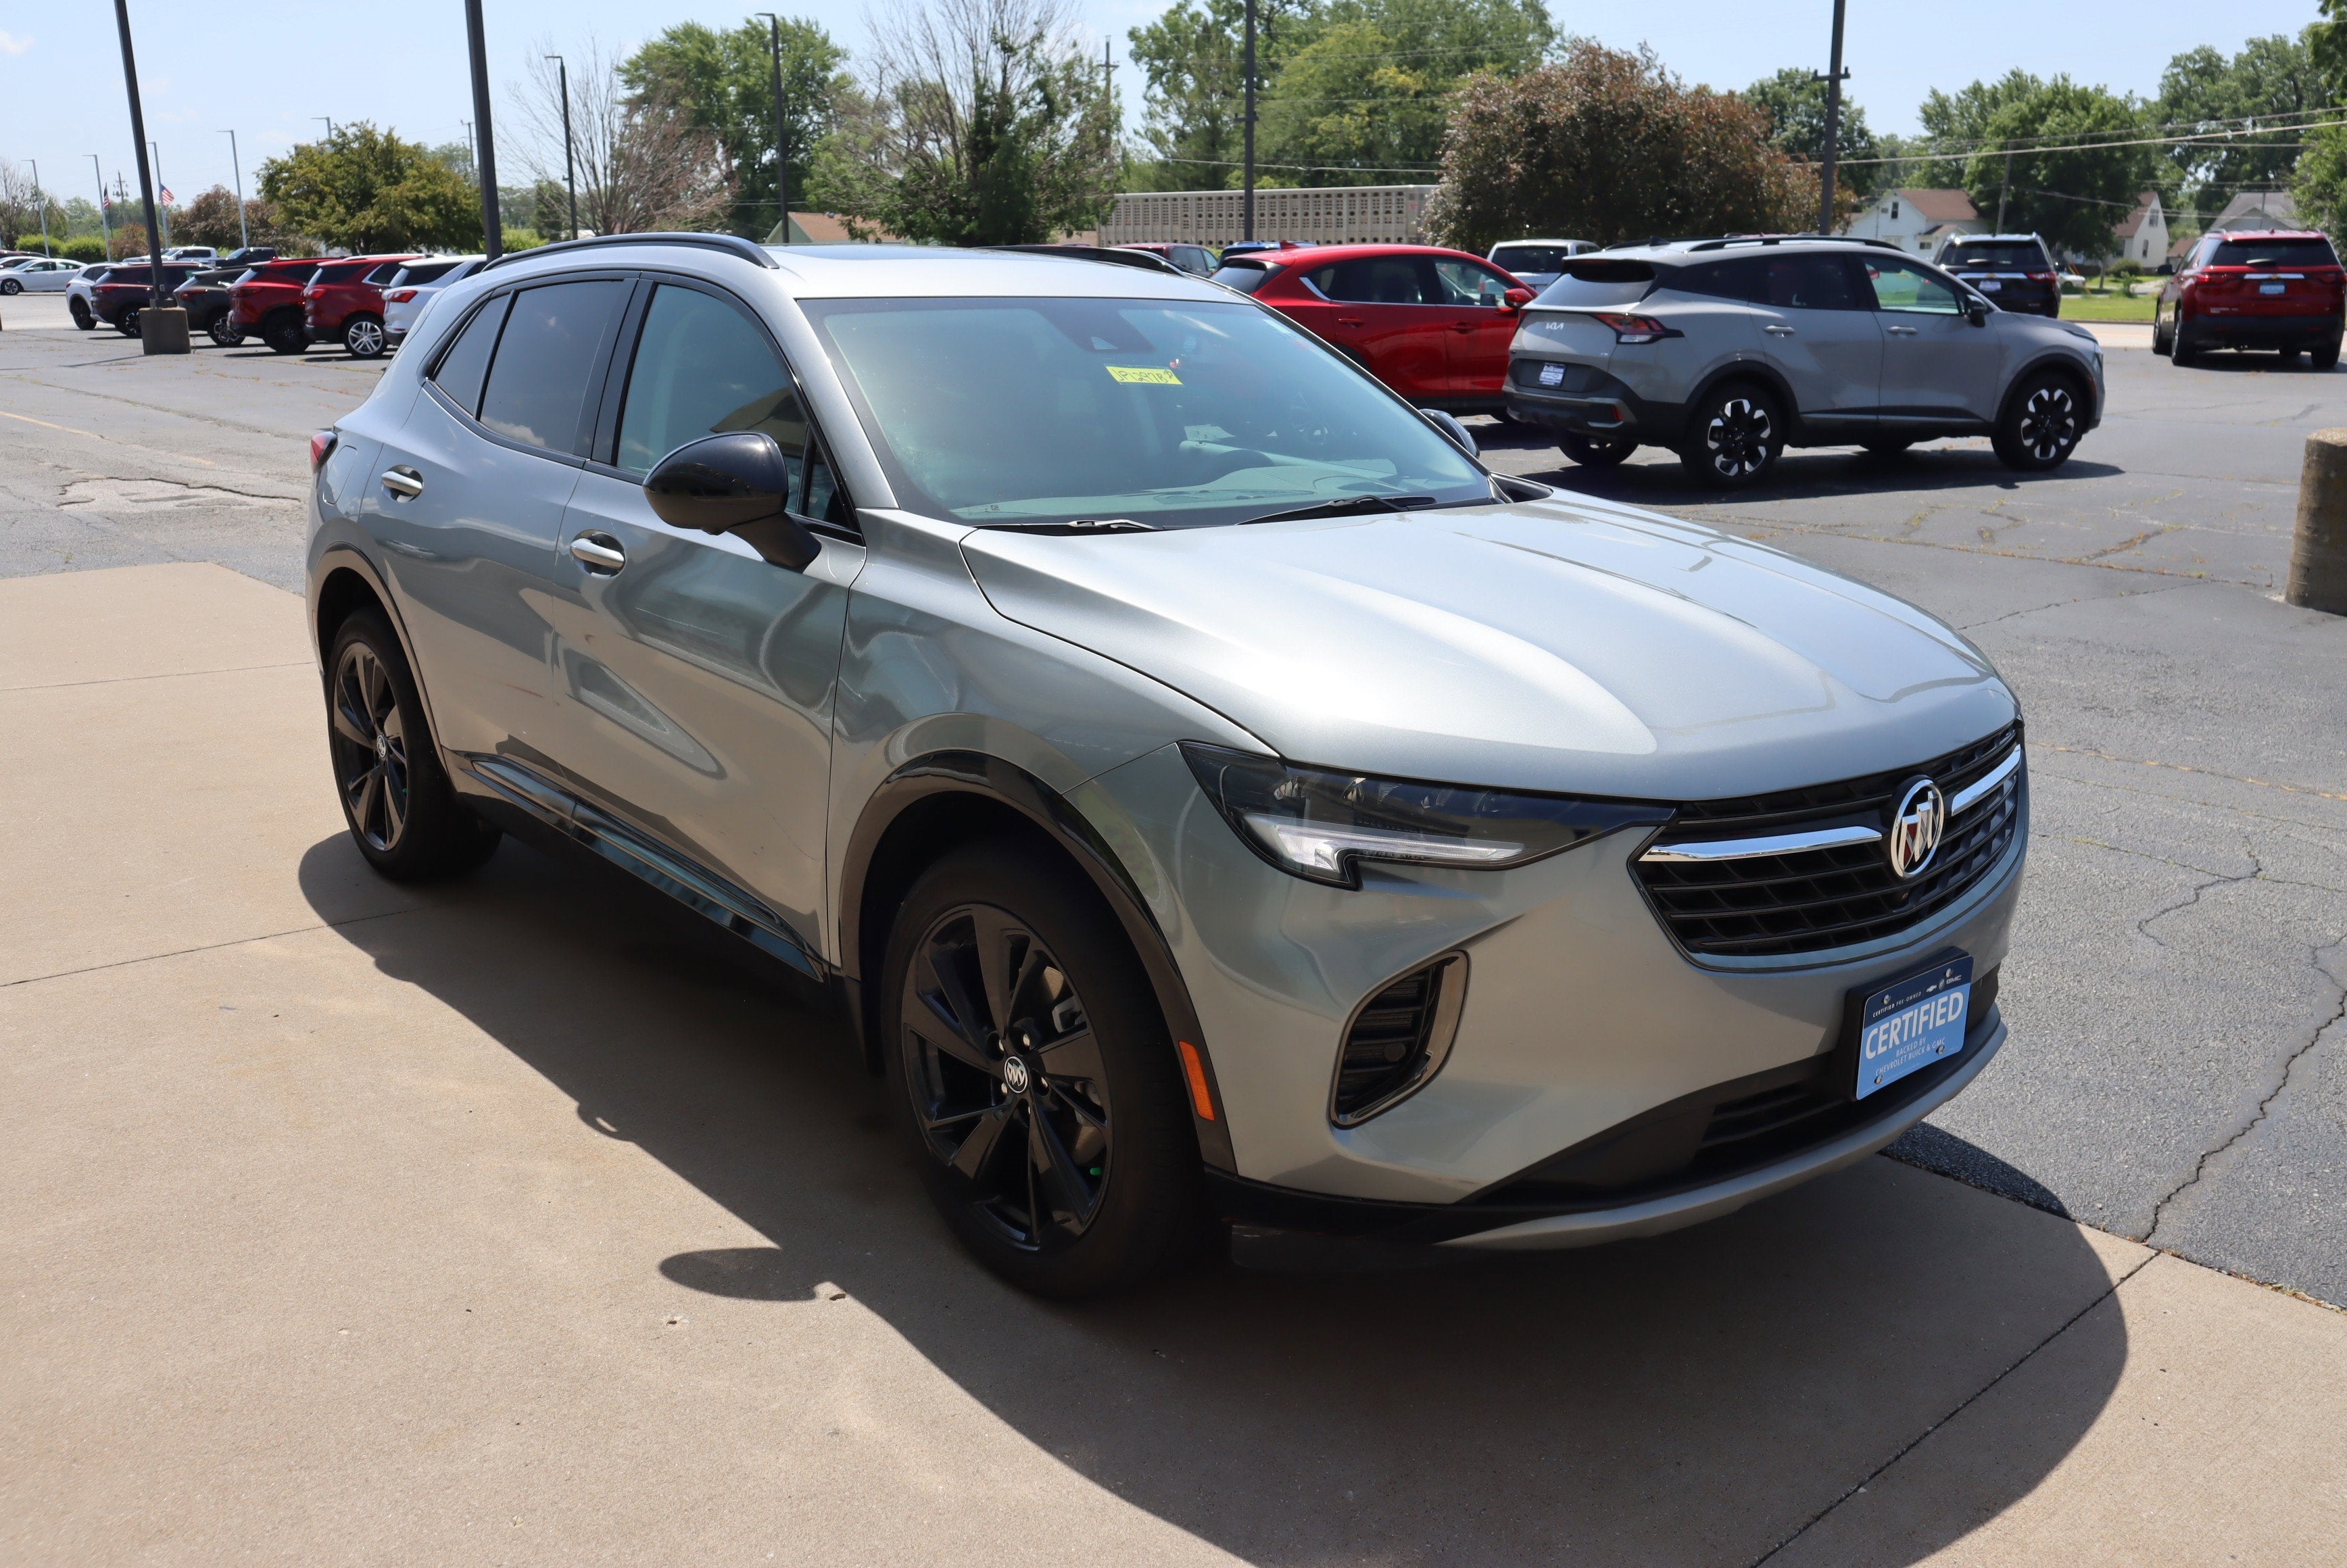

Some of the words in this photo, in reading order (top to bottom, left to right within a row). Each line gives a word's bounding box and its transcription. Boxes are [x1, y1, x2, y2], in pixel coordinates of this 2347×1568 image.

[1545, 322, 1564, 330] KIA
[1946, 975, 1962, 985] GMC
[1872, 1003, 1895, 1018] CERTIFIED
[1896, 991, 1922, 1007] PRE-OWNED
[1866, 991, 1963, 1059] CERTIFIED
[1875, 1055, 1908, 1077] CHEVROLET
[1908, 1046, 1925, 1060] BUICK
[1932, 1037, 1945, 1049] GMC
[1896, 1042, 1918, 1057] BACKED
[1919, 1037, 1927, 1046] BY
